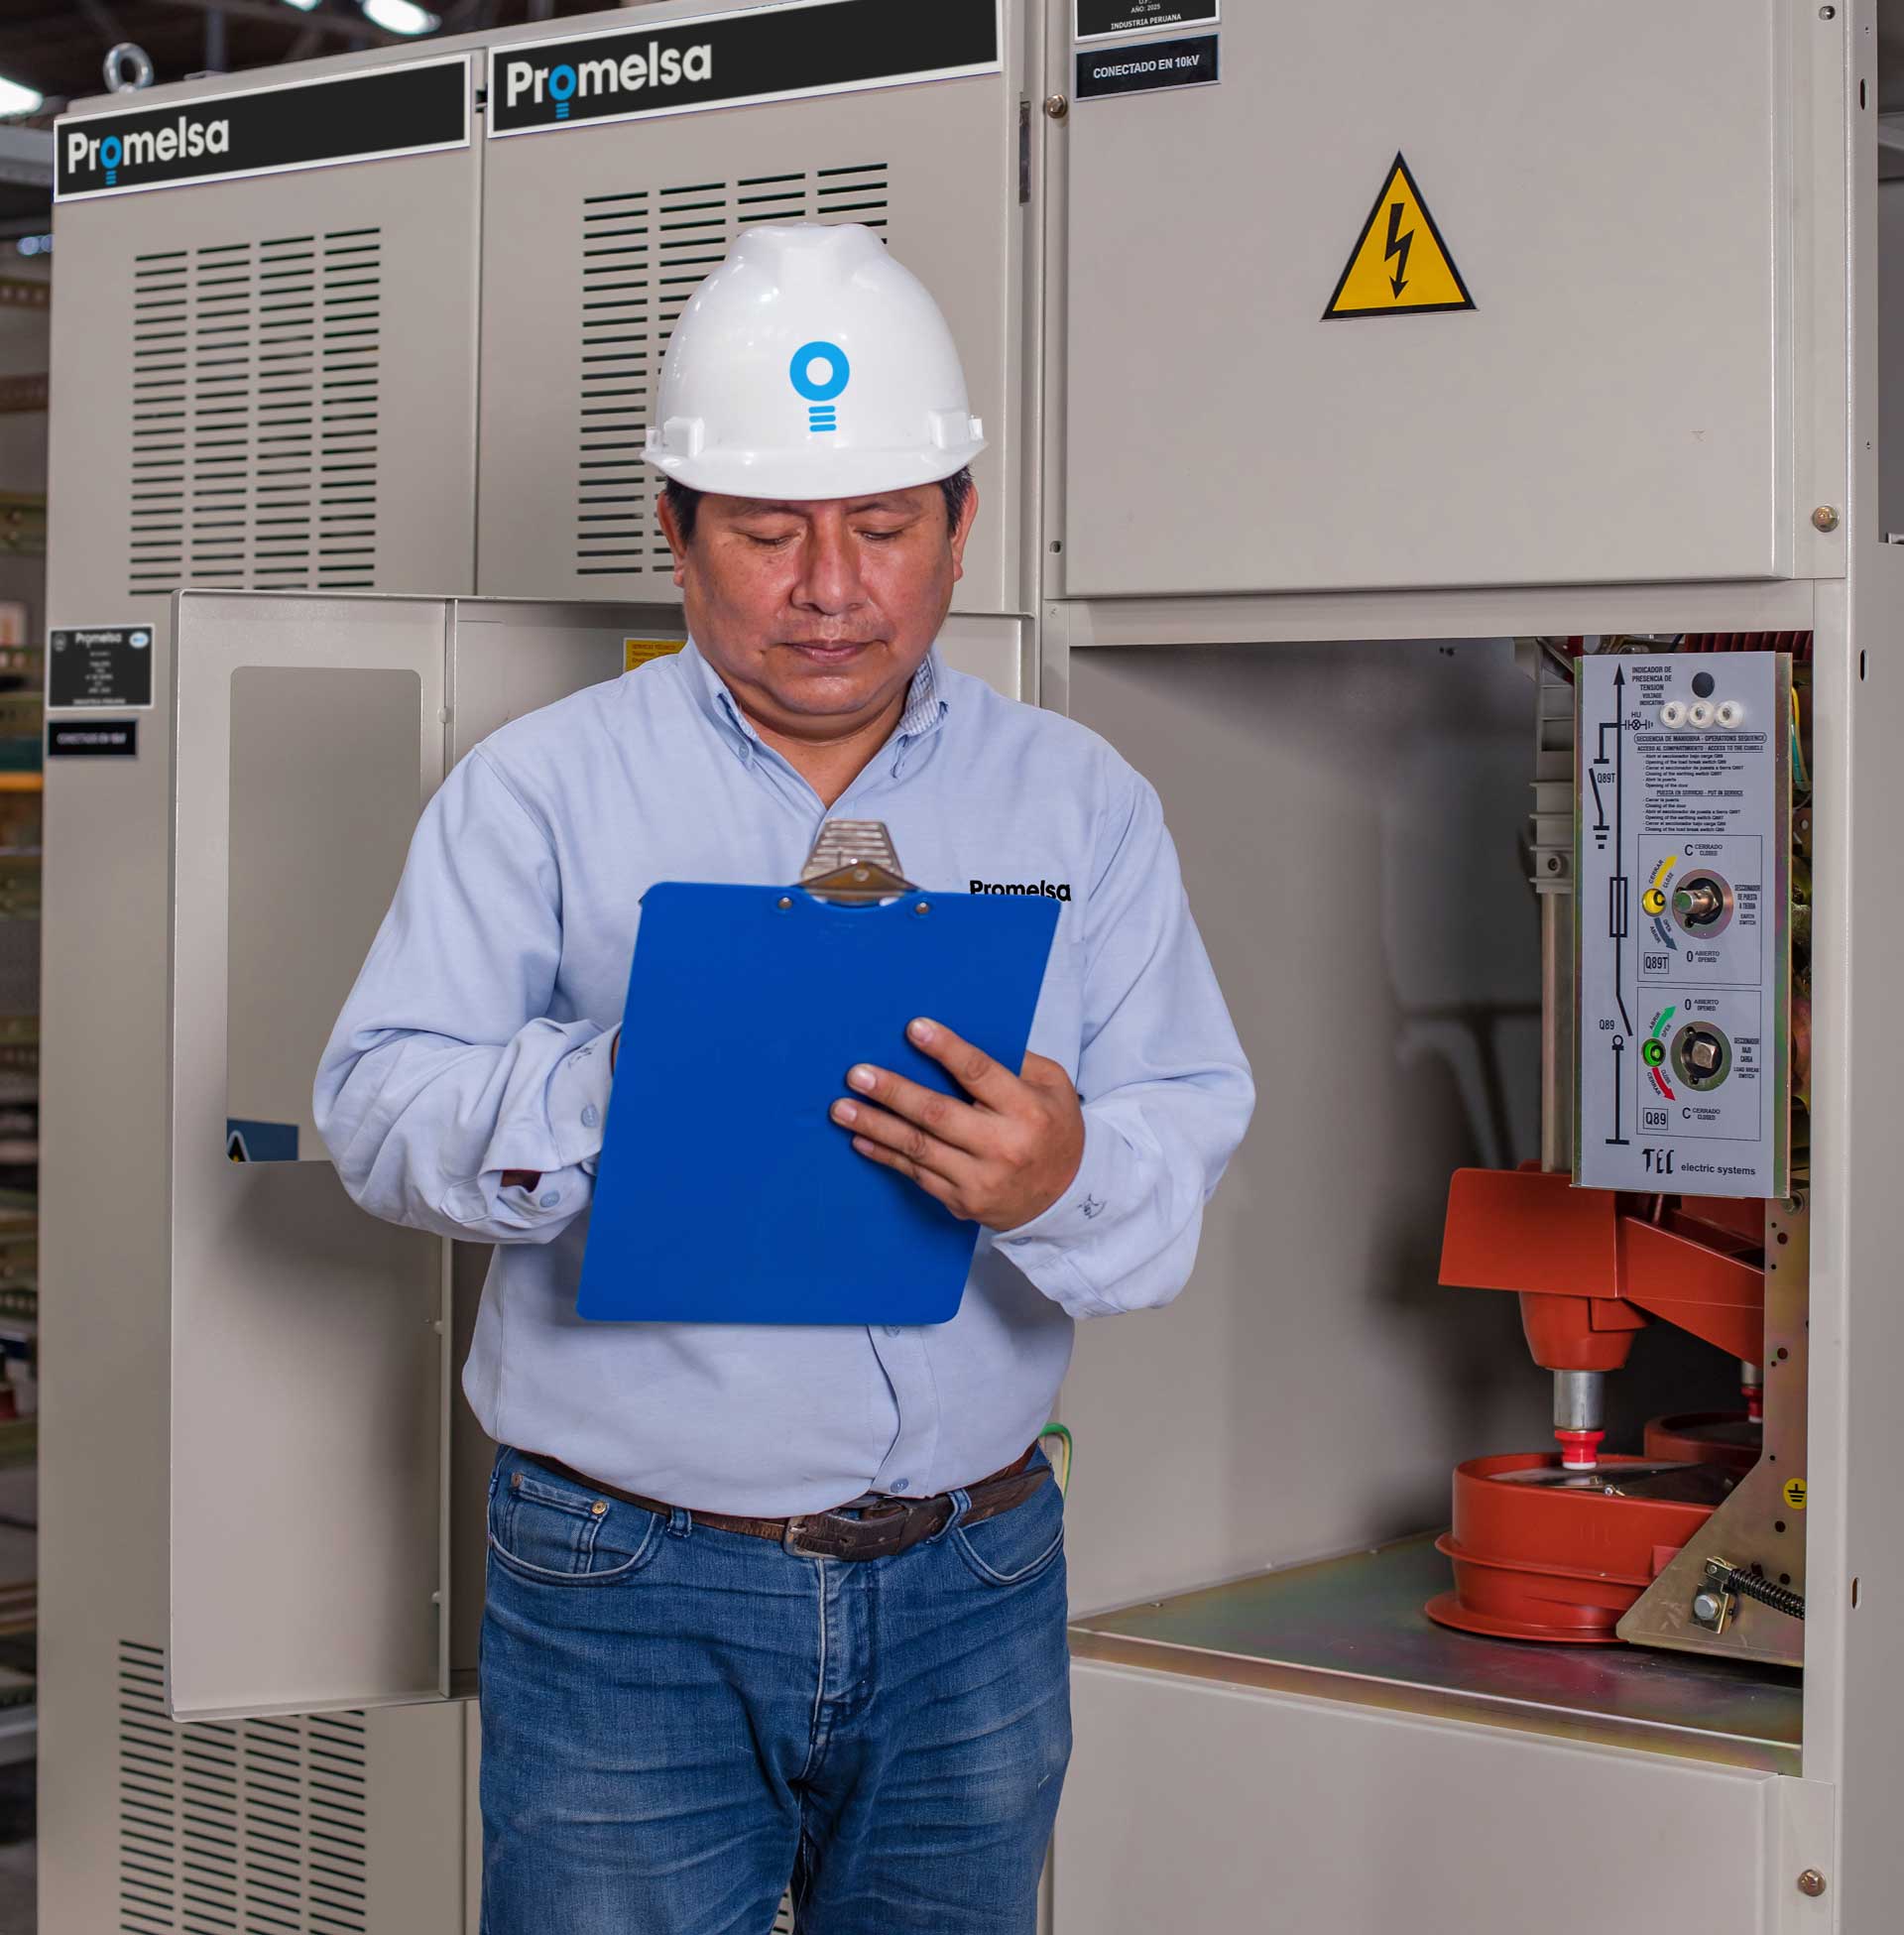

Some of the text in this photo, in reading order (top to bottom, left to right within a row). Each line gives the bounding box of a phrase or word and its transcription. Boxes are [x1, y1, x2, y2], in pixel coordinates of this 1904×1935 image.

[1111, 13, 1182, 30] INDUSTRIA PERUANA
[1093, 55, 1200, 78] CONECTADO EN 10kV
[507, 40, 712, 121] Promelsa
[66, 116, 230, 185] Promelsa
[1597, 773, 1615, 784] Q89T
[1684, 844, 1693, 856] C
[1649, 859, 1664, 884] CERRAR
[1646, 956, 1668, 969] Q89T
[1599, 1019, 1614, 1030] Q89
[1646, 1112, 1666, 1125] Q89
[1682, 1107, 1691, 1119] C
[1681, 1163, 1715, 1173] electric
[1718, 1165, 1756, 1176] systems
